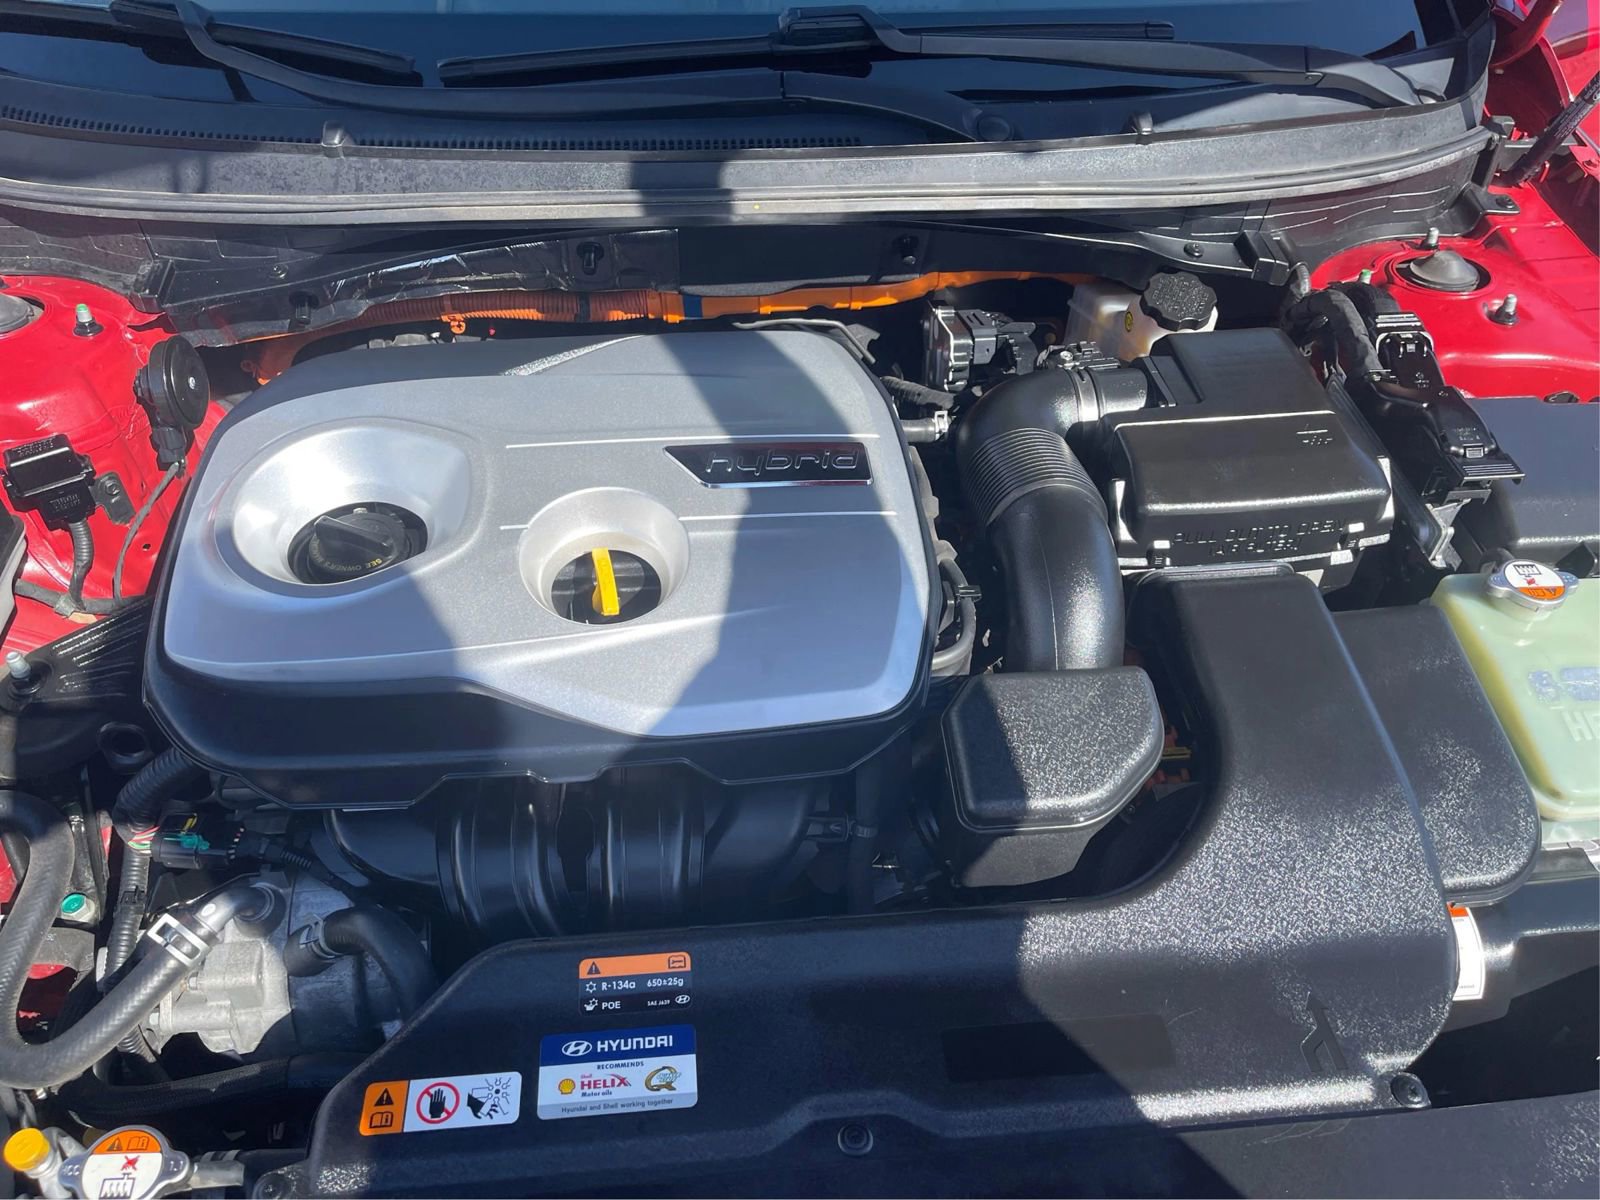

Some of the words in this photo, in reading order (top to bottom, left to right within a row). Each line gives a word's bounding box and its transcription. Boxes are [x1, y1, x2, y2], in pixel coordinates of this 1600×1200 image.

[705, 450, 859, 476] hybrid
[366, 558, 383, 569] SEE
[601, 980, 636, 991] R-134a
[646, 977, 684, 988] 650±25g
[601, 1001, 621, 1010] POE
[597, 1035, 673, 1053] HYUNDAI
[596, 1061, 644, 1070] RECOMMENDS
[580, 1074, 632, 1090] HELIX
[561, 1105, 588, 1114] Hyundai
[603, 1102, 618, 1111] Shell
[620, 1100, 646, 1110] working
[647, 1098, 674, 1107] together
